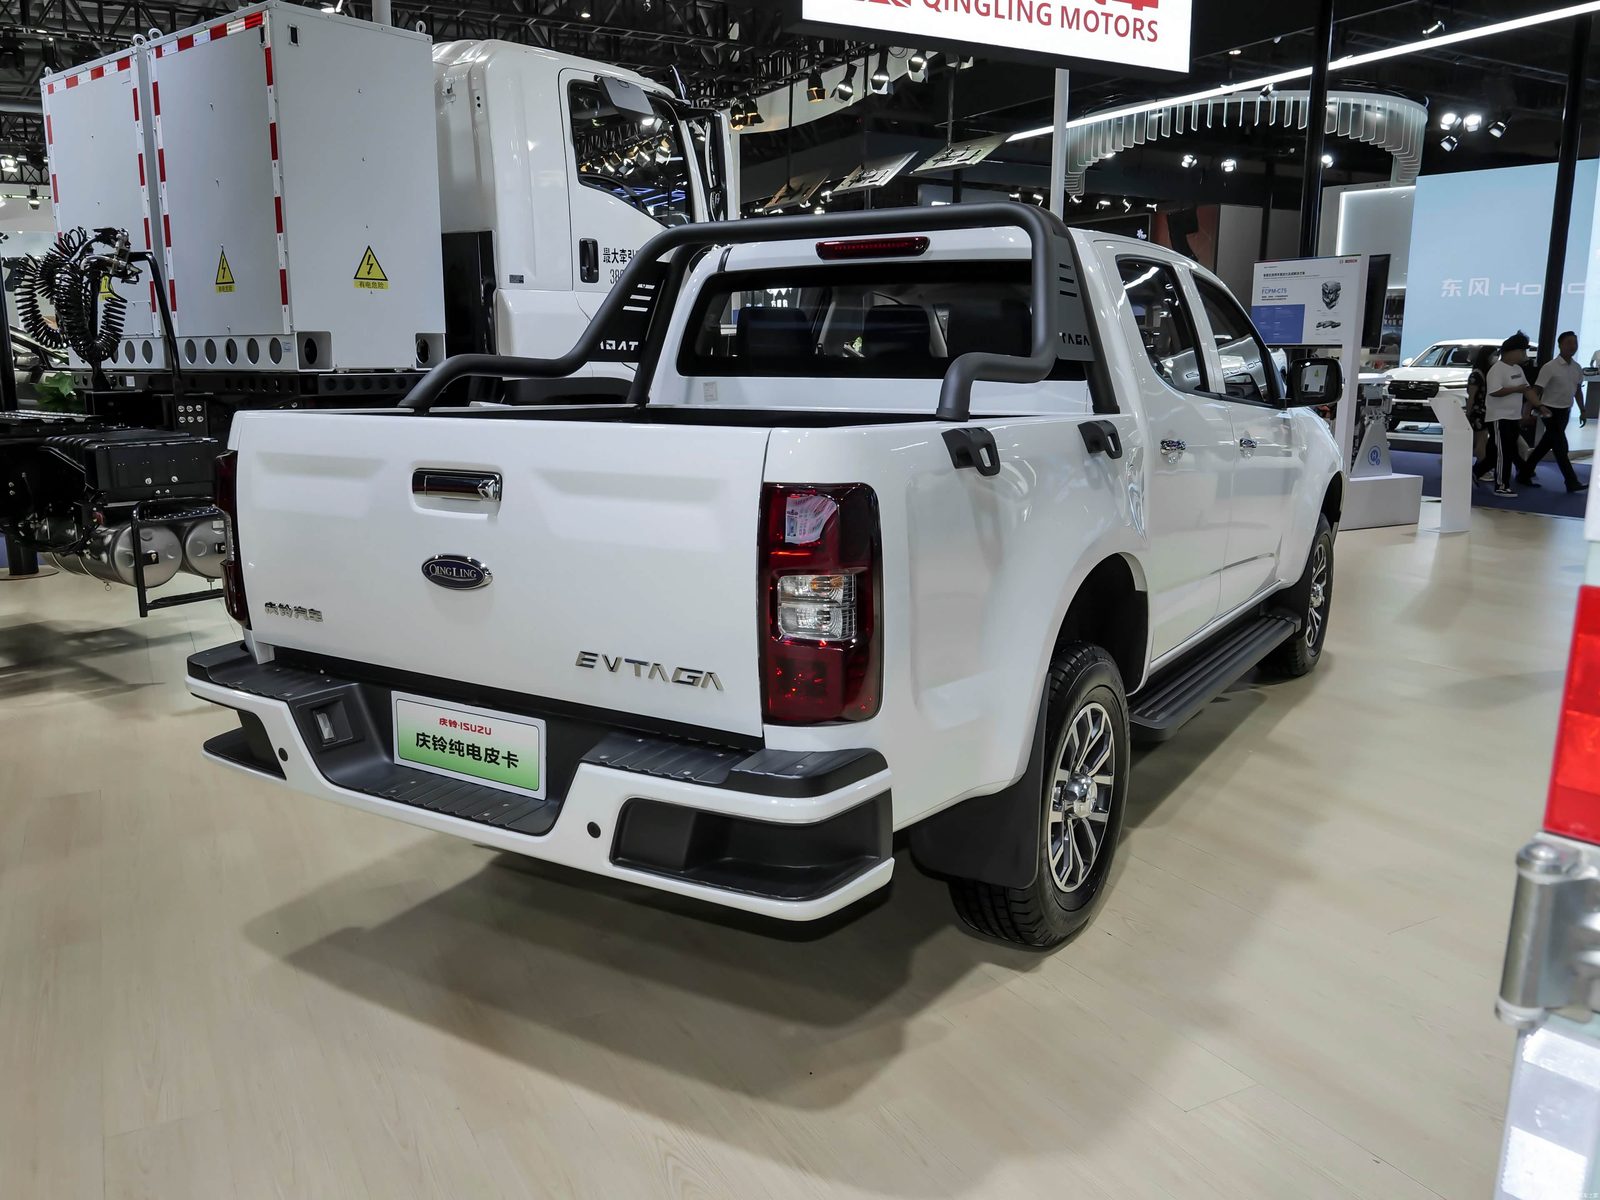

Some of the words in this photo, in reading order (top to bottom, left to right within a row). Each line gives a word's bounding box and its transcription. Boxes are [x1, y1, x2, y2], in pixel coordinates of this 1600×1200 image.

[1061, 5, 1158, 42] MOTORS
[603, 247, 639, 264] 最大牵引
[1441, 277, 1490, 297] 东风
[430, 564, 477, 578] QINGLING
[575, 651, 724, 691] EVTAGA
[416, 732, 519, 768] 庆铃纯电皮卡
